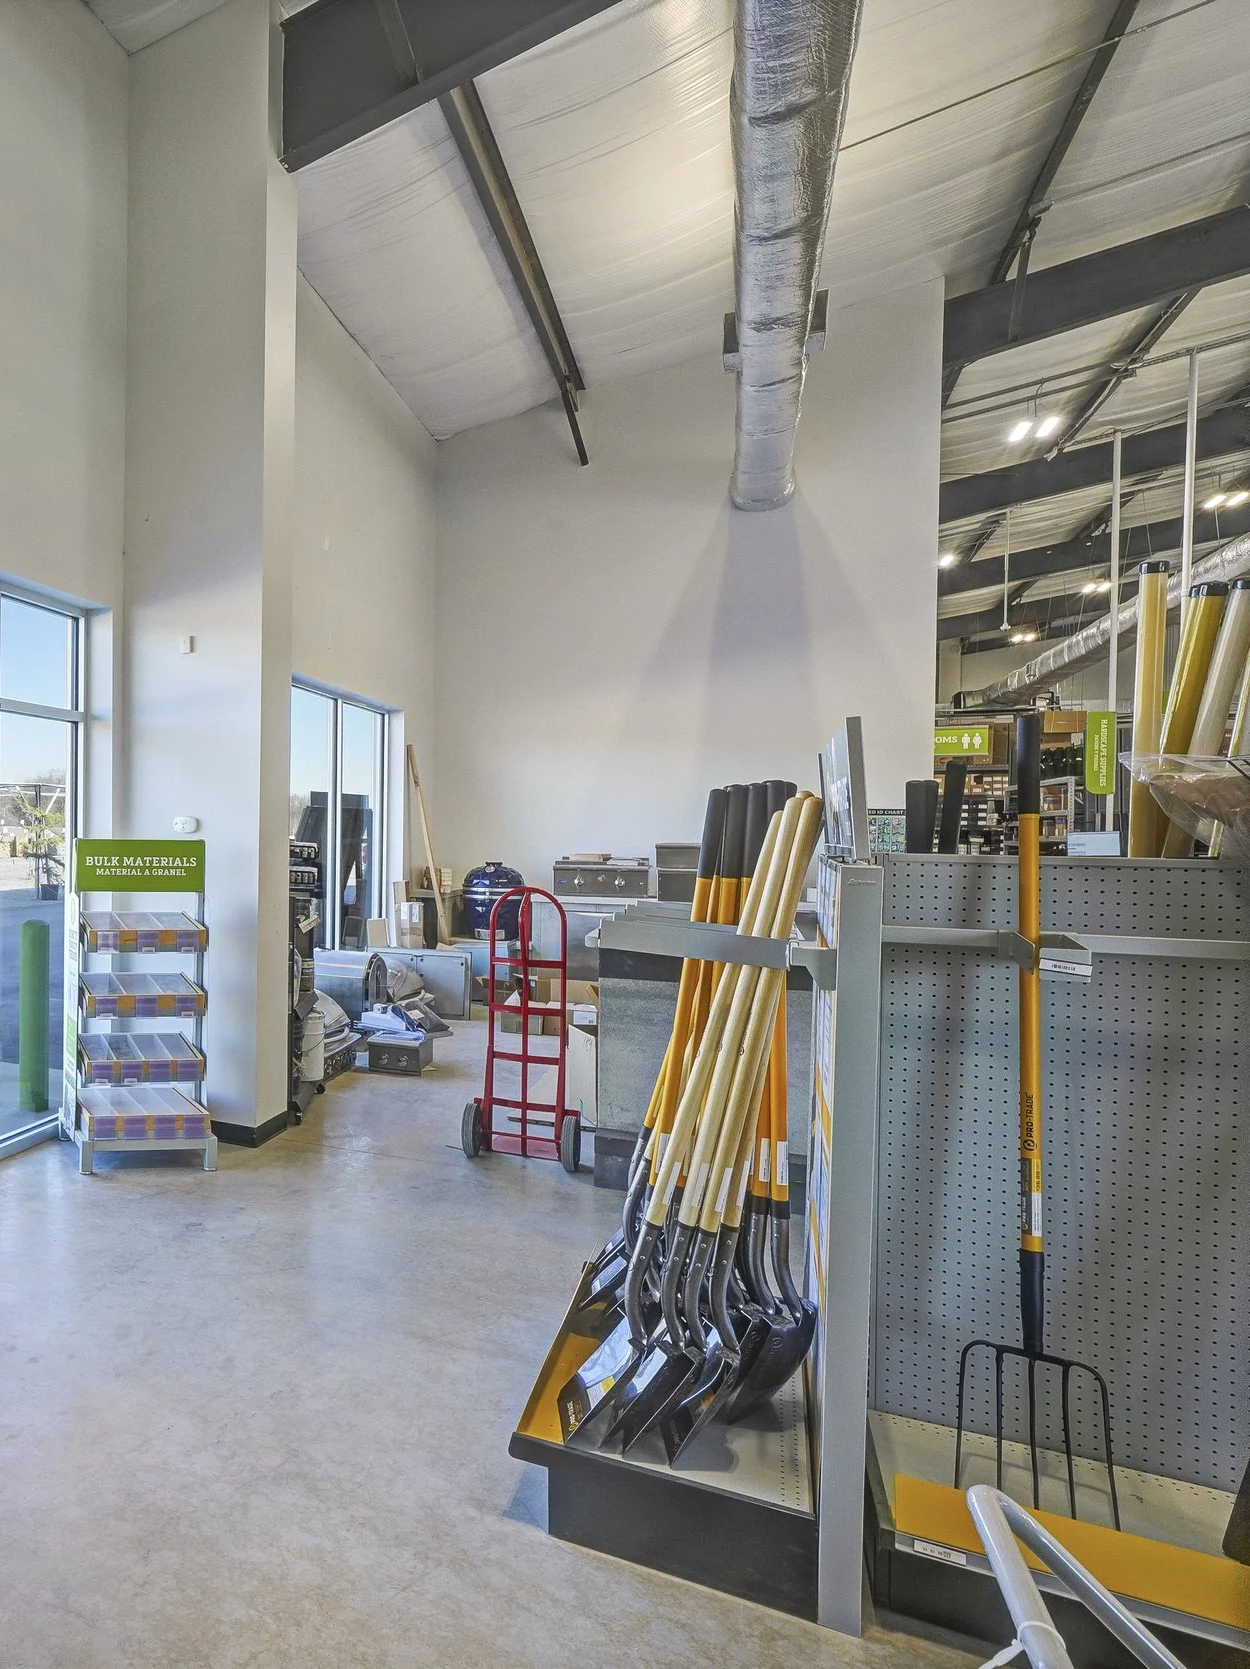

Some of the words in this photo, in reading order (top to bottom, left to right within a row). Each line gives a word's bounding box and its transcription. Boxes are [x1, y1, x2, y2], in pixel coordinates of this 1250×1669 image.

[1100, 719, 1108, 756] HARDSCAPE
[1099, 756, 1107, 787] SUPPLIES
[85, 856, 120, 866] BULK
[122, 856, 197, 867] MATERIALS
[96, 868, 142, 876] MATERIAL
[143, 868, 151, 876] A
[152, 868, 187, 876] GRANEL
[1025, 1093, 1034, 1138] PRO-TRADE
